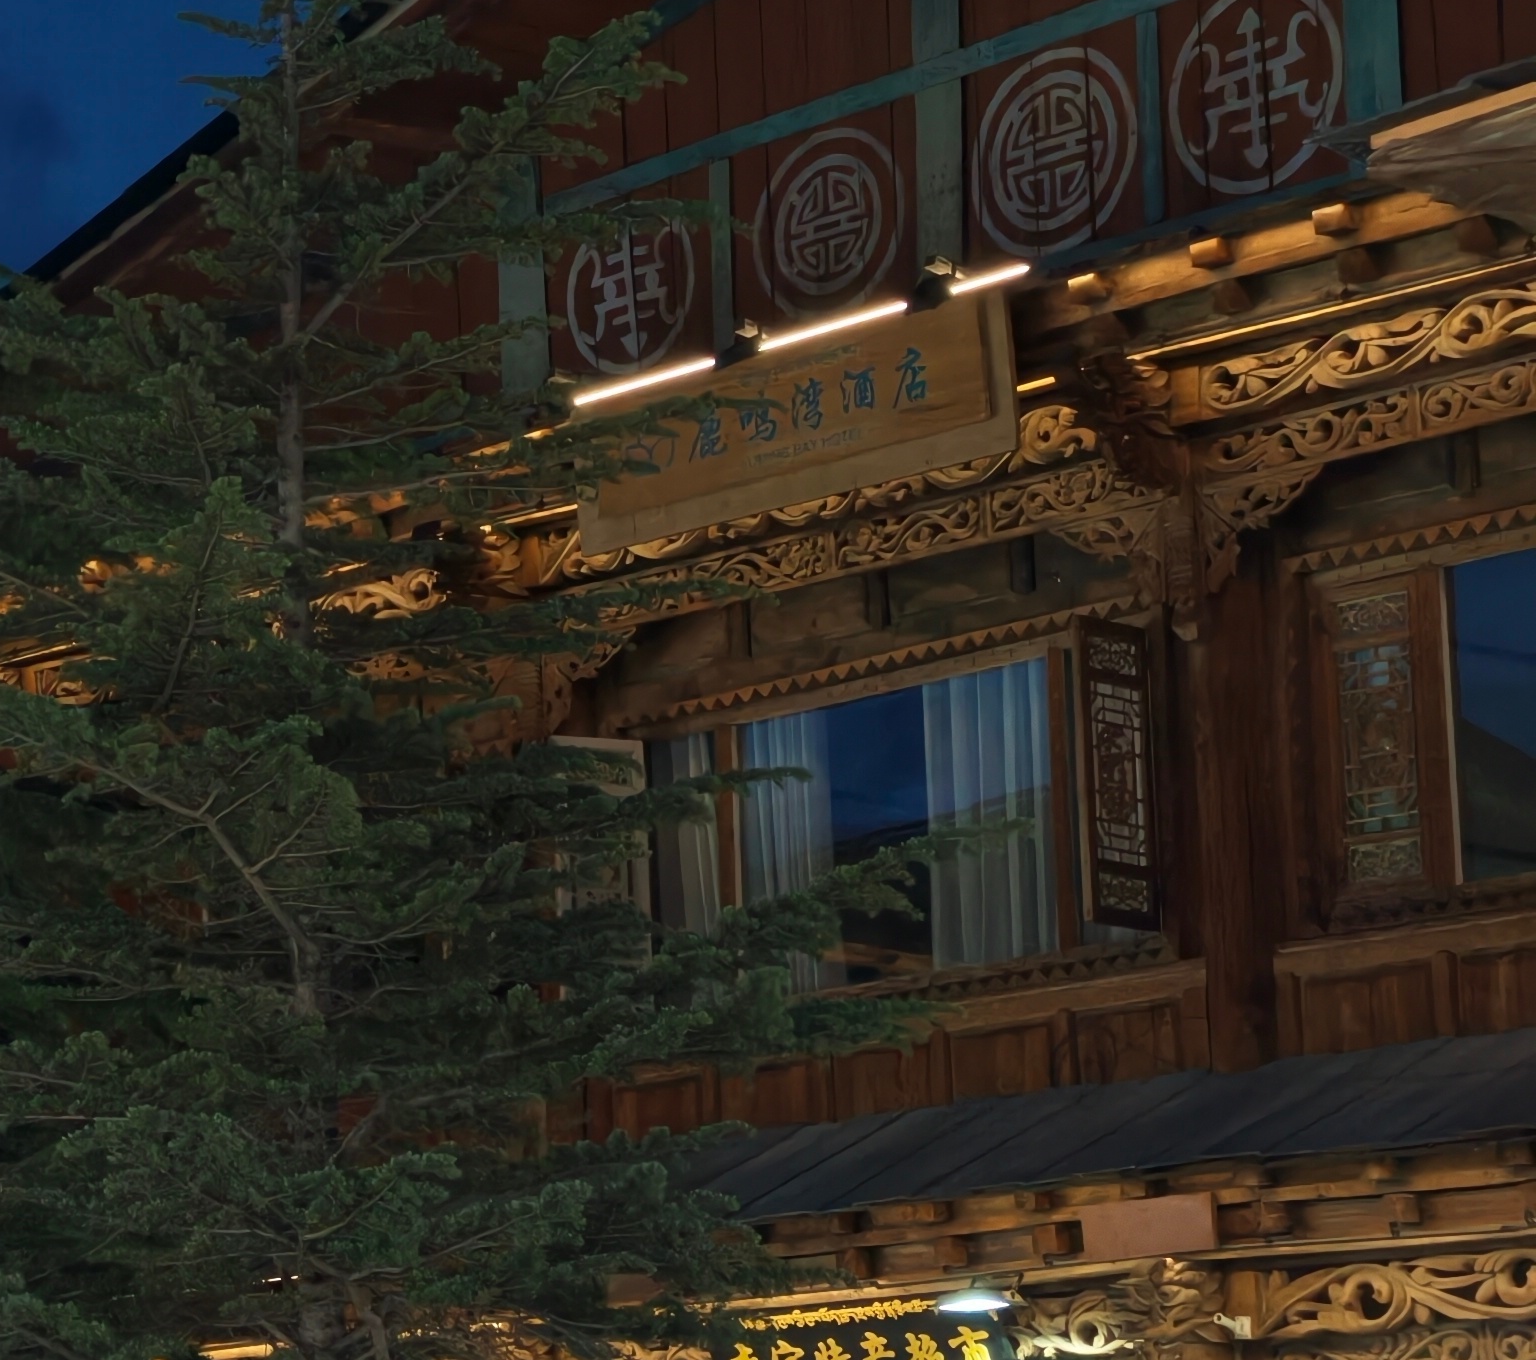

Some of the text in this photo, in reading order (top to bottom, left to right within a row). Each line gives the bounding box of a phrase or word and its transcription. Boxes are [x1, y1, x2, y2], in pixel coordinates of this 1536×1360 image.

[689, 347, 929, 464] 鹿鸣湾酒店
